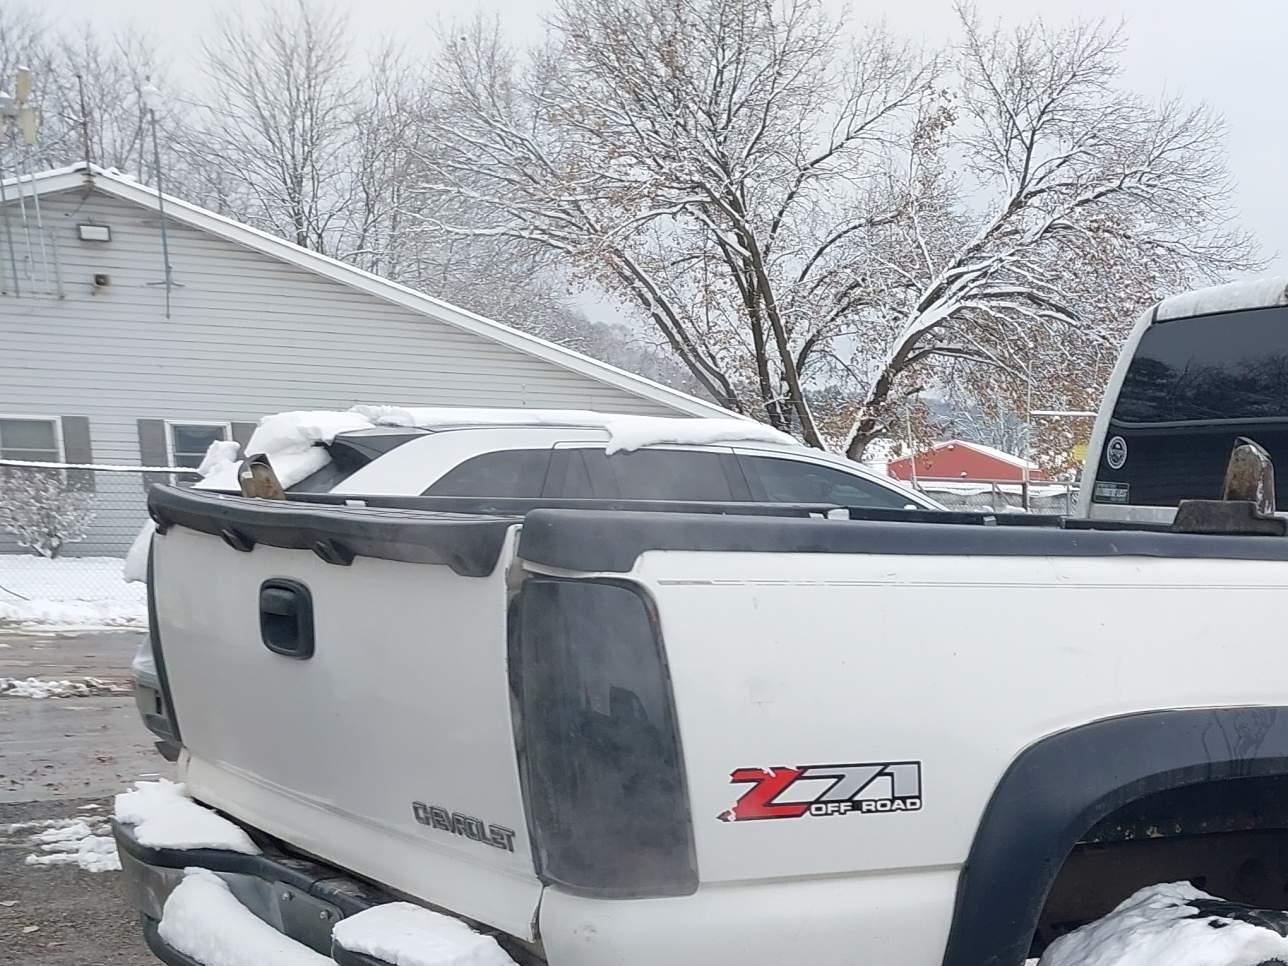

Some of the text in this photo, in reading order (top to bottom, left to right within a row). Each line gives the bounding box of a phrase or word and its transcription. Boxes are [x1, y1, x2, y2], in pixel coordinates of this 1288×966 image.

[716, 761, 921, 822] Z71
[810, 798, 921, 815] OFF ROAD
[412, 801, 516, 852] CHEVROLET
